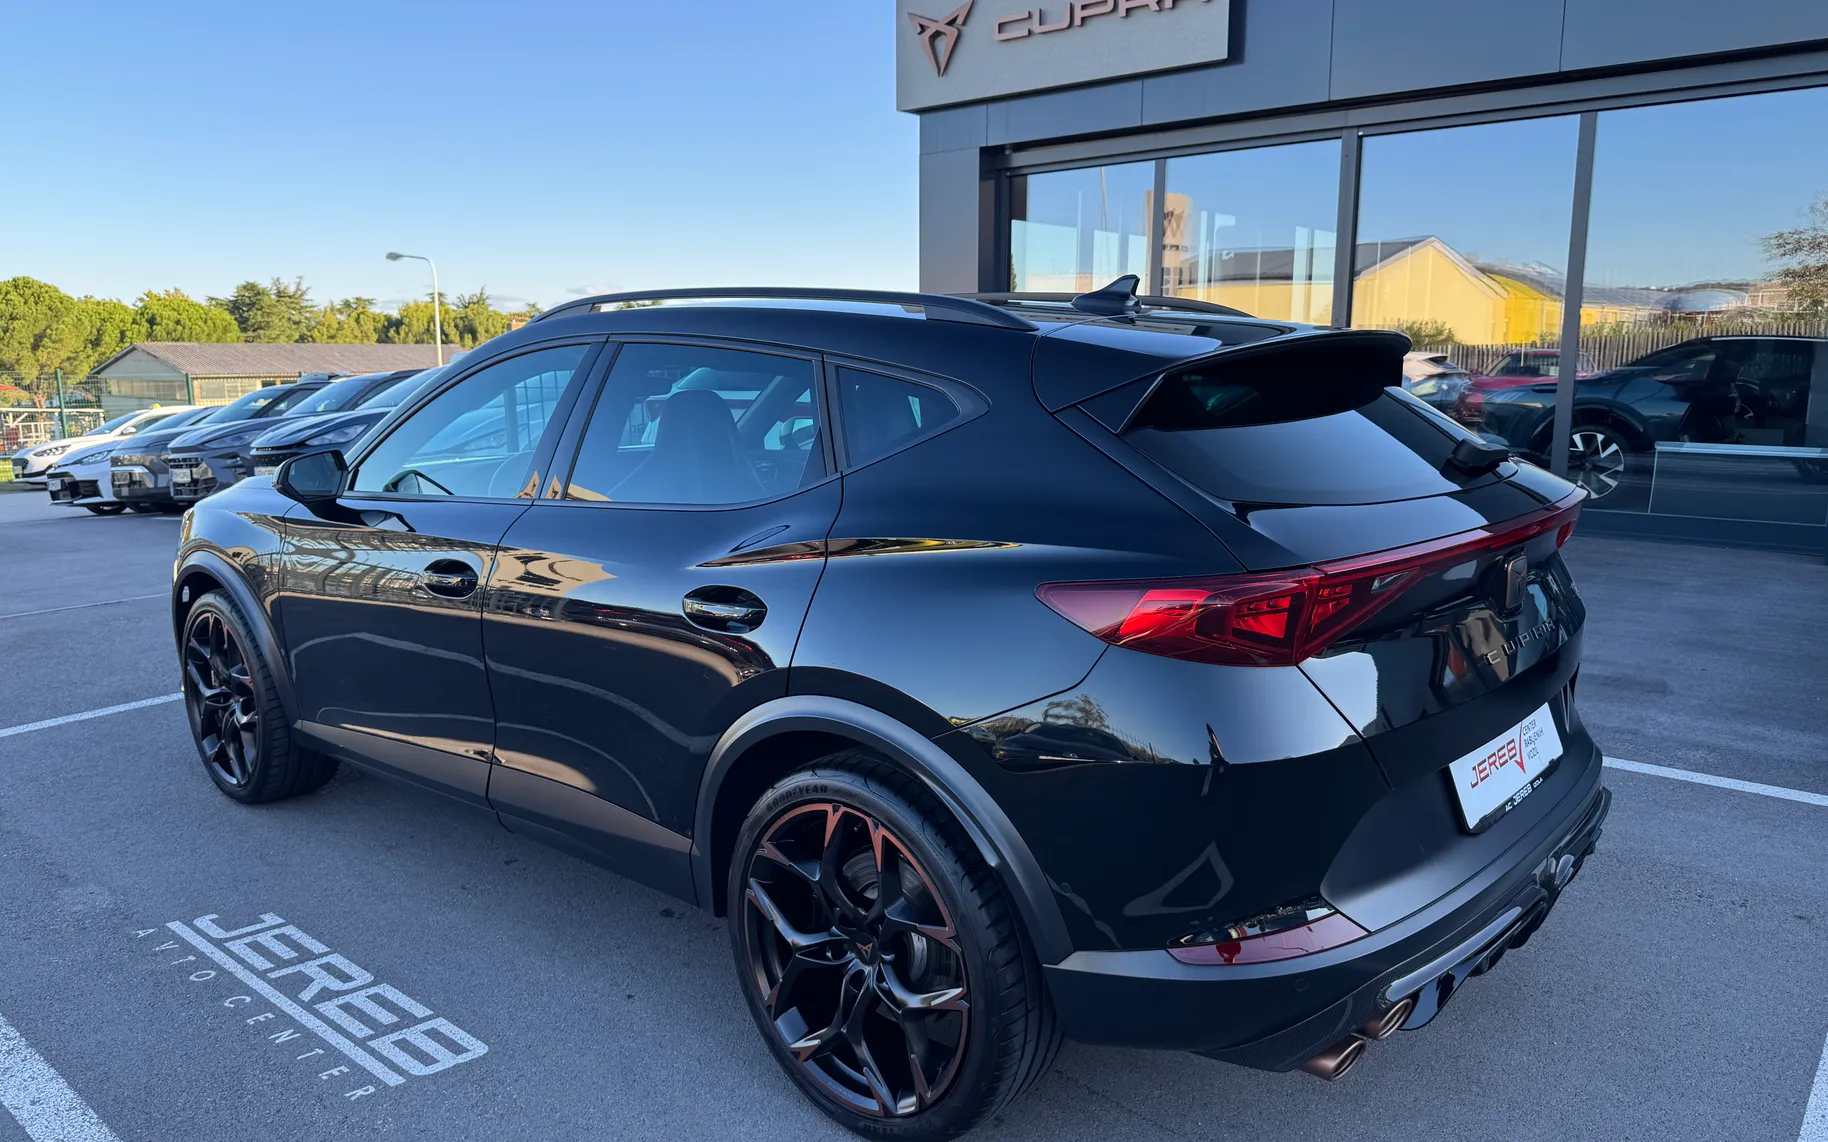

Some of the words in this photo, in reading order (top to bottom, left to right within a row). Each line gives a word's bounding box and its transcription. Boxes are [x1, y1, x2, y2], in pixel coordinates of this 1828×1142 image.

[1484, 619, 1556, 665] CUPRA
[1470, 738, 1518, 789] JEREB
[766, 784, 828, 812] GOODYEAR
[1512, 783, 1533, 806] JEREB
[132, 928, 216, 981] AVTO
[223, 996, 375, 1100] CENTER
[193, 912, 489, 1076] JEREB
